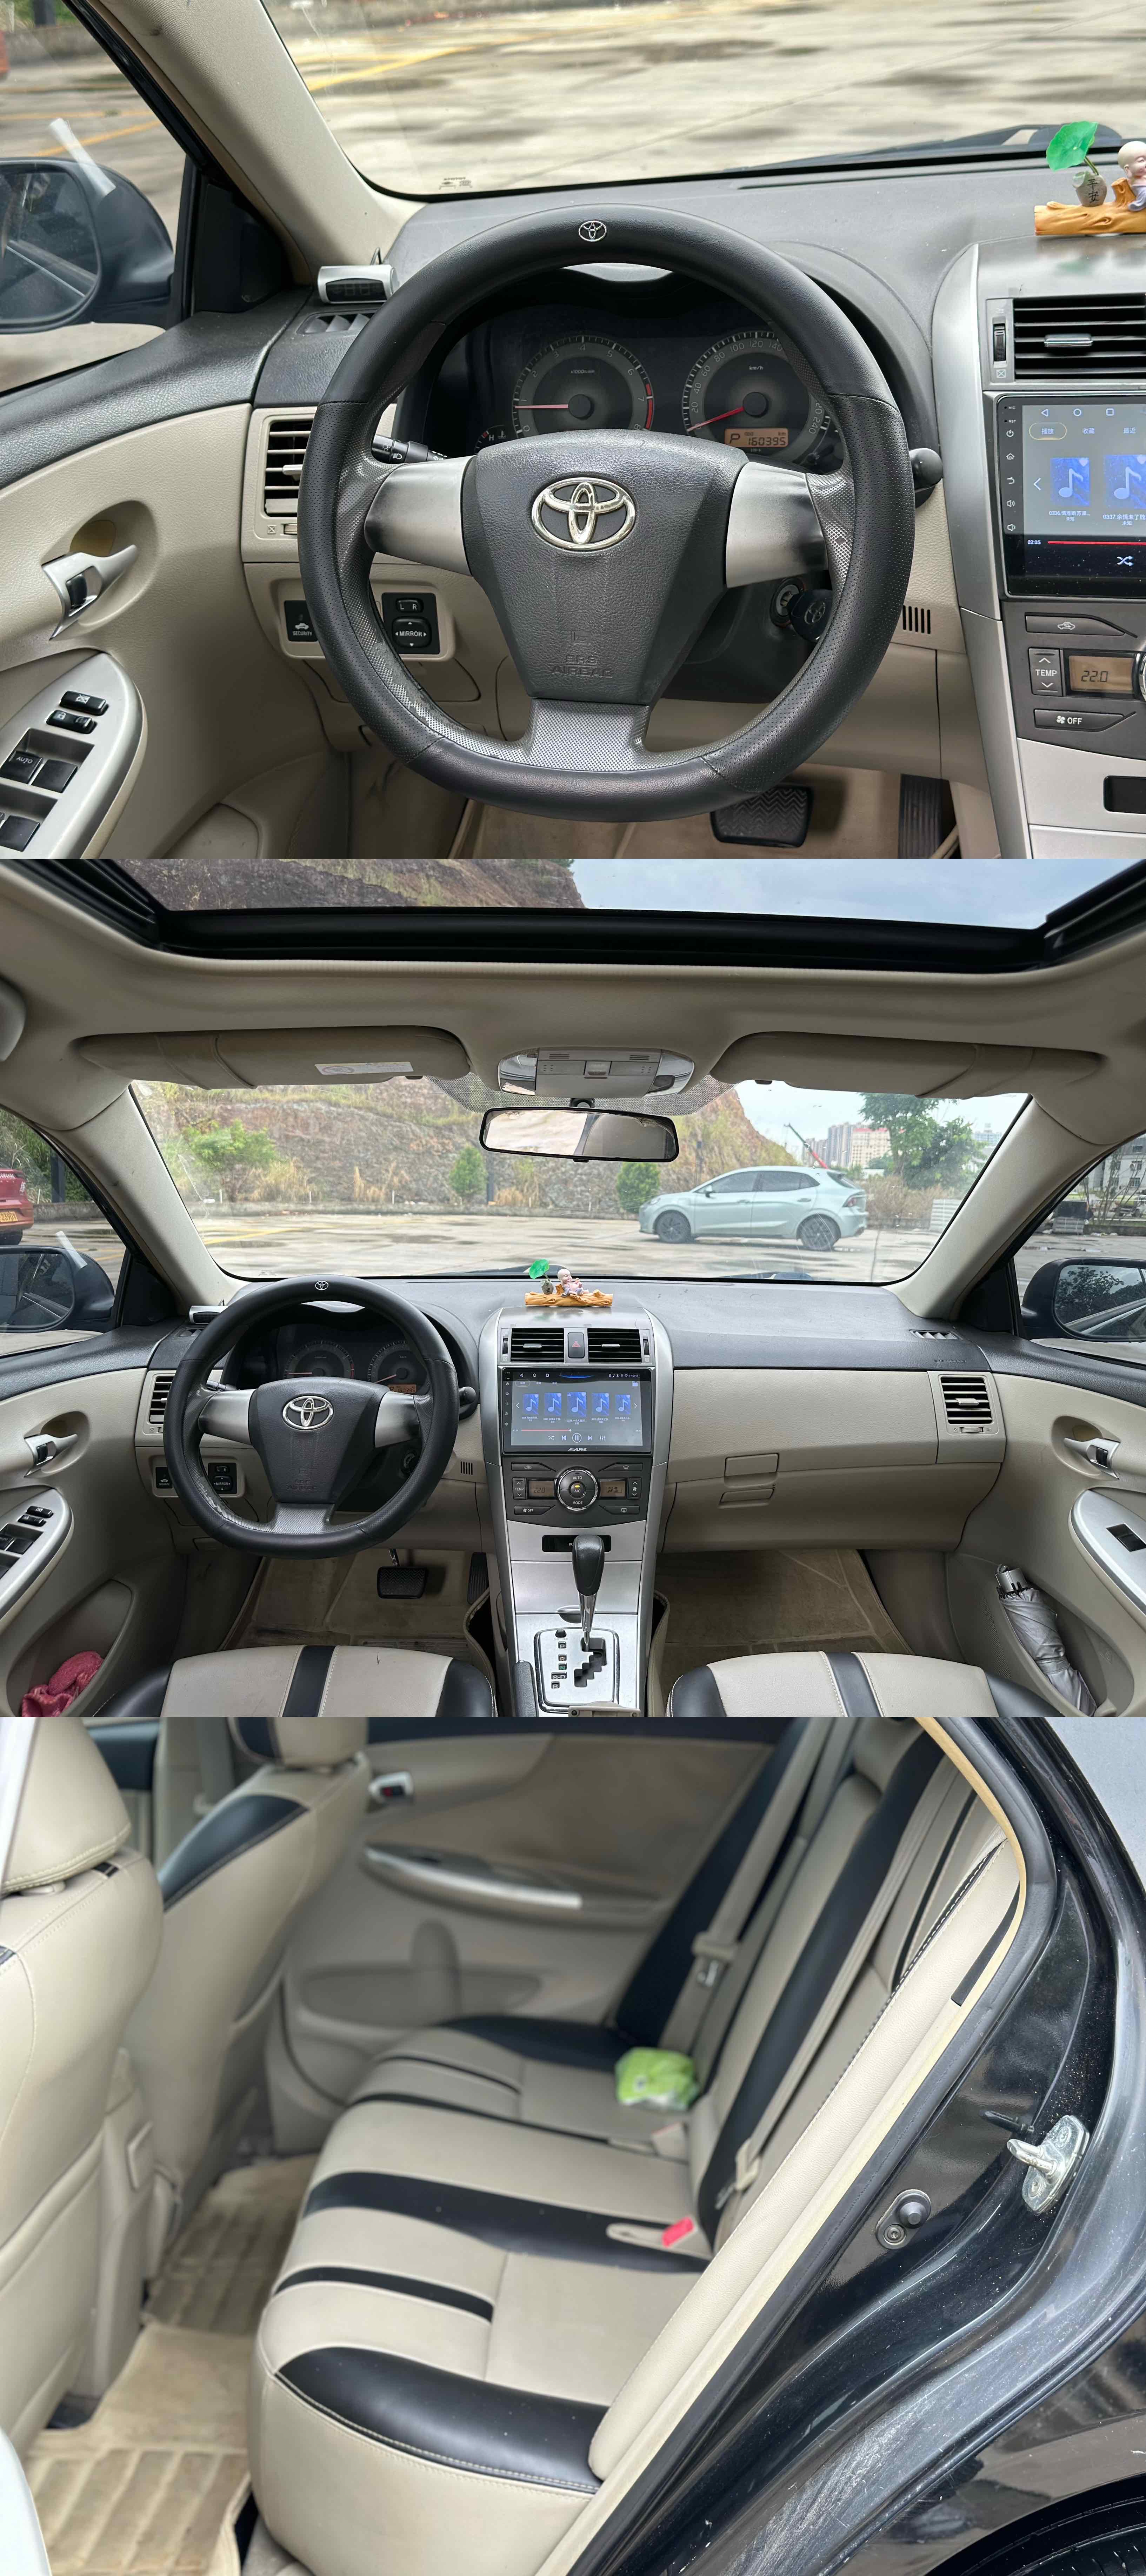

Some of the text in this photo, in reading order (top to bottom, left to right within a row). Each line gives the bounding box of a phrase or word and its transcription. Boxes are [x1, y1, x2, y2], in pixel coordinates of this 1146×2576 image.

[1087, 178, 1099, 203] 平安
[729, 343, 744, 352] 100
[714, 352, 725, 362] 80
[701, 366, 711, 376] 60
[694, 383, 701, 394] 40
[691, 402, 698, 413] 20
[809, 416, 820, 434] 240
[729, 433, 740, 444] P
[748, 437, 786, 446] 160395
[1081, 670, 1109, 683] 22.0
